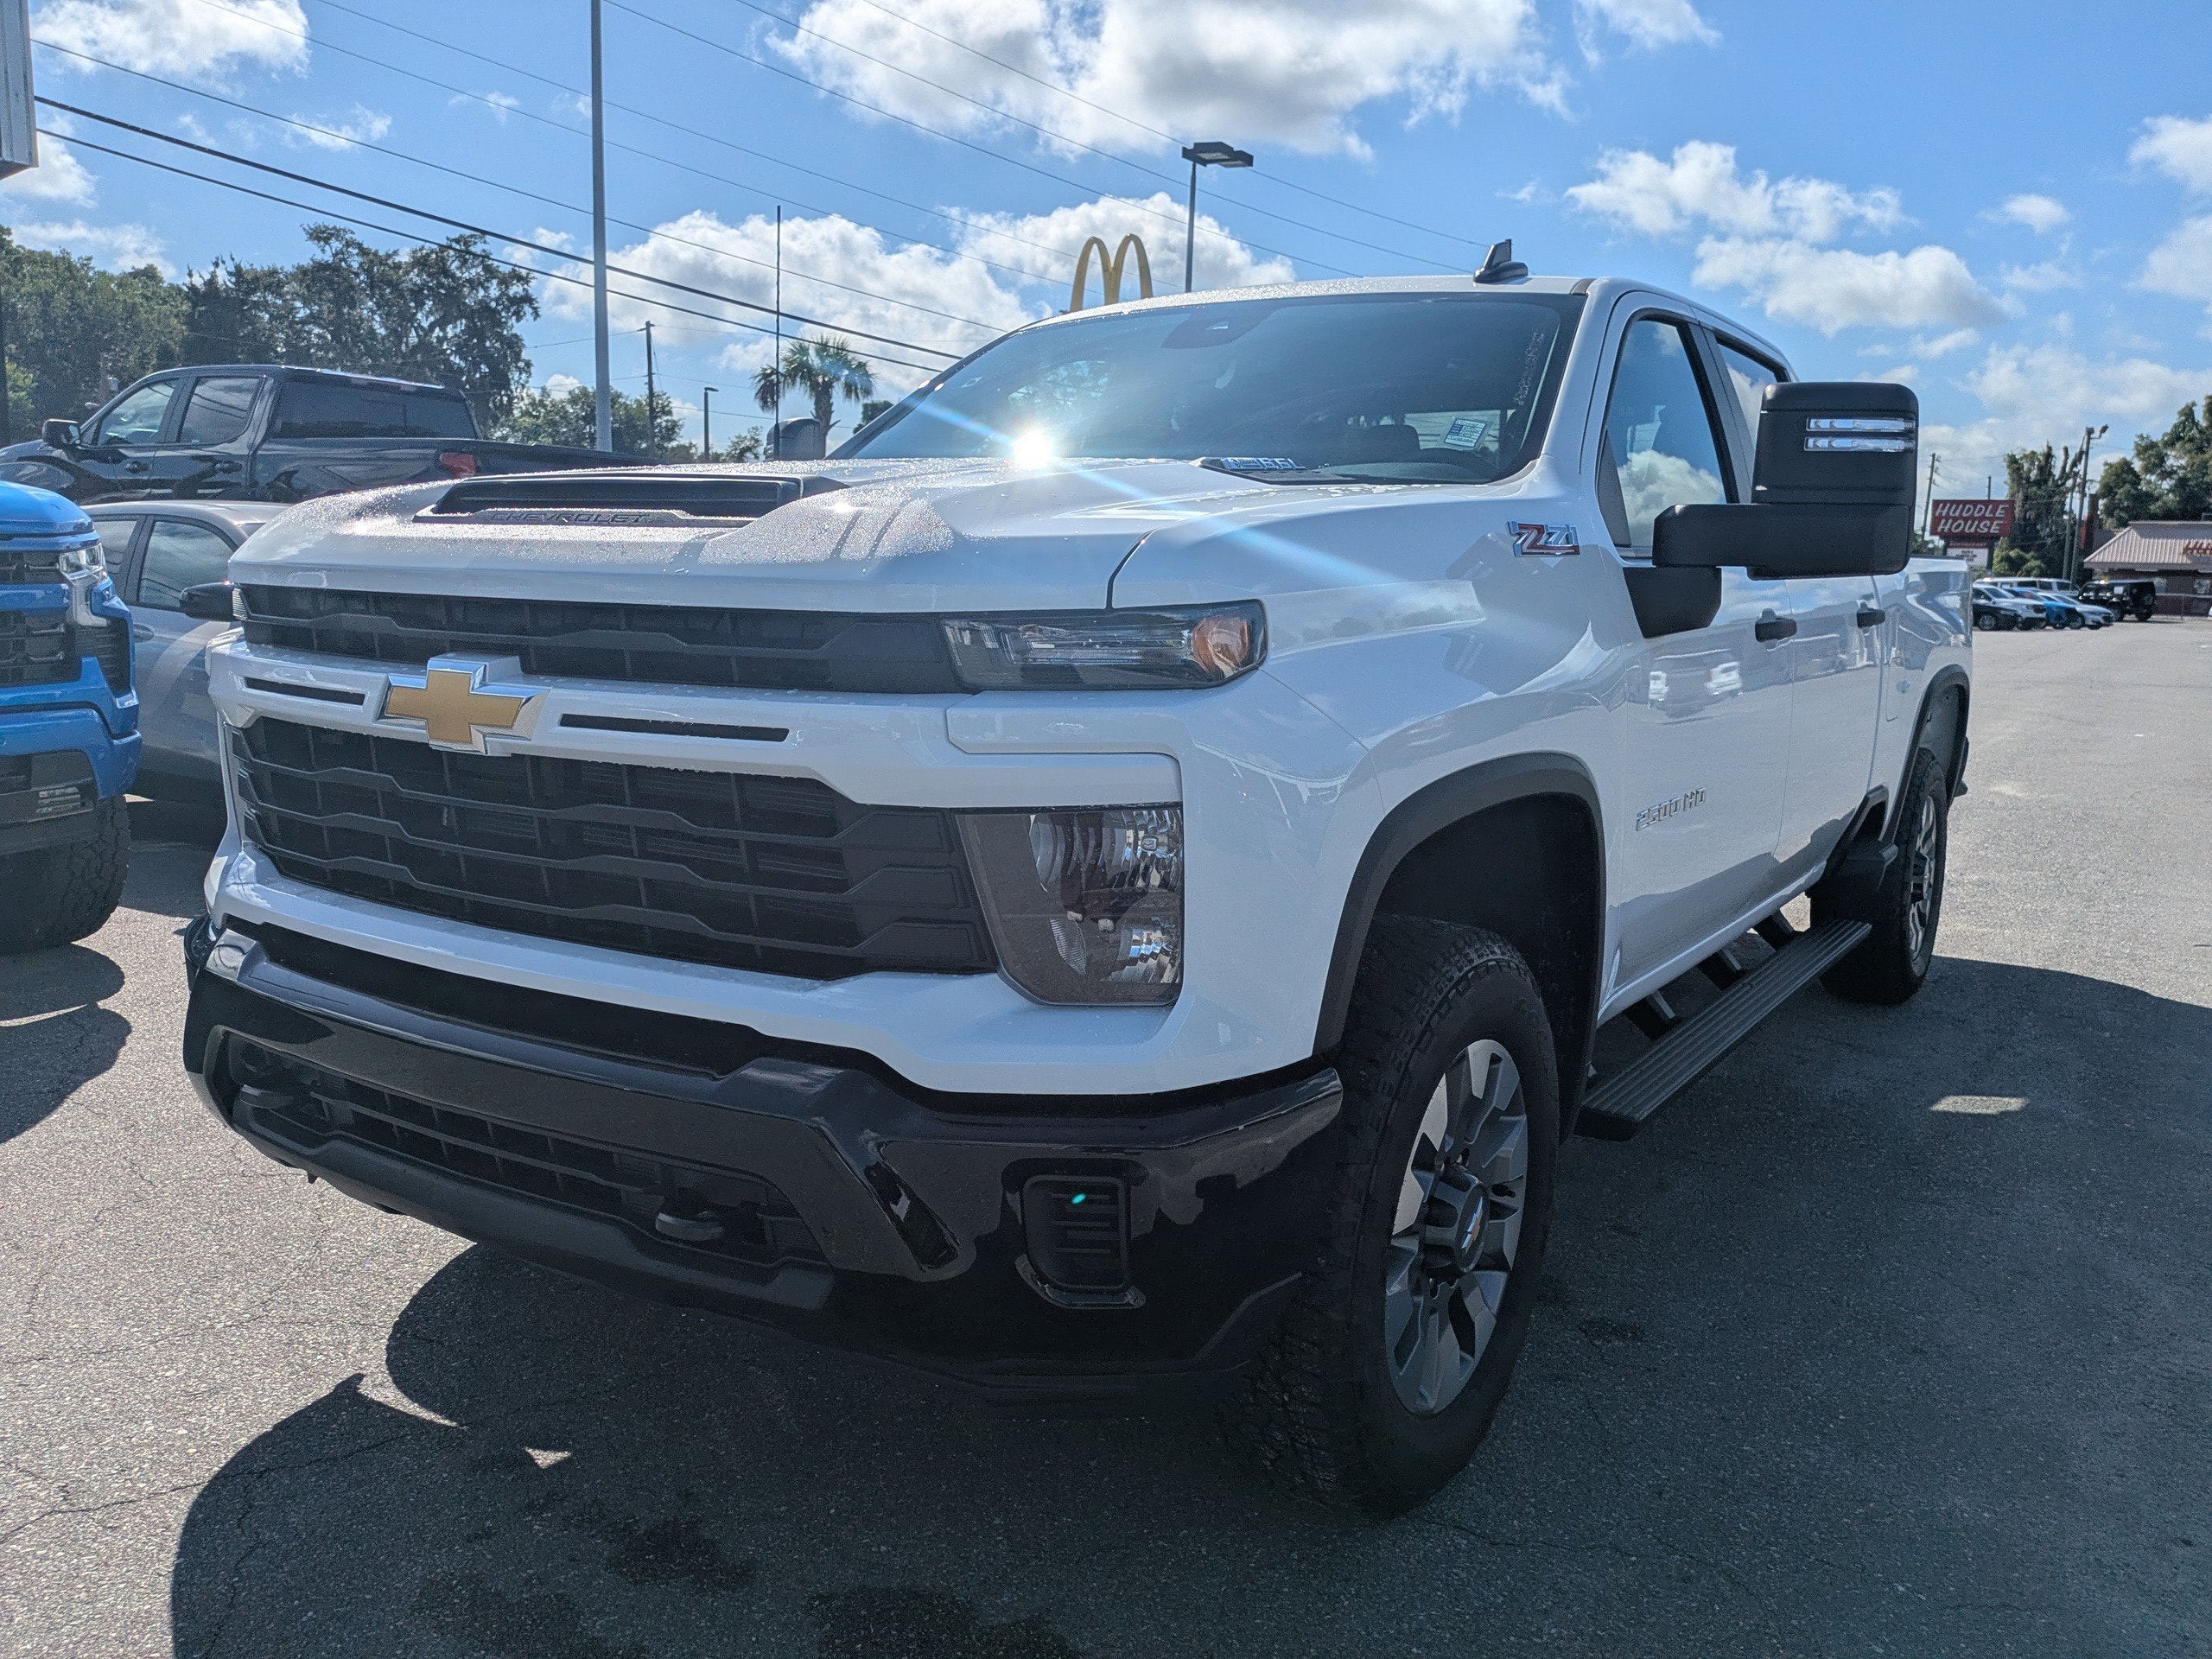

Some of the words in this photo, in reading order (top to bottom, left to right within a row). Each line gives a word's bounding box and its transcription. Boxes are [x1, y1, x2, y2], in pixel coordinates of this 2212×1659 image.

[490, 512, 648, 524] CHEVROLET
[1936, 503, 2009, 518] HUDDLE
[1936, 518, 2004, 533] HOUSE
[1506, 521, 1580, 557] Z71
[1636, 797, 1681, 831] 2500
[1683, 786, 1707, 811] HD
